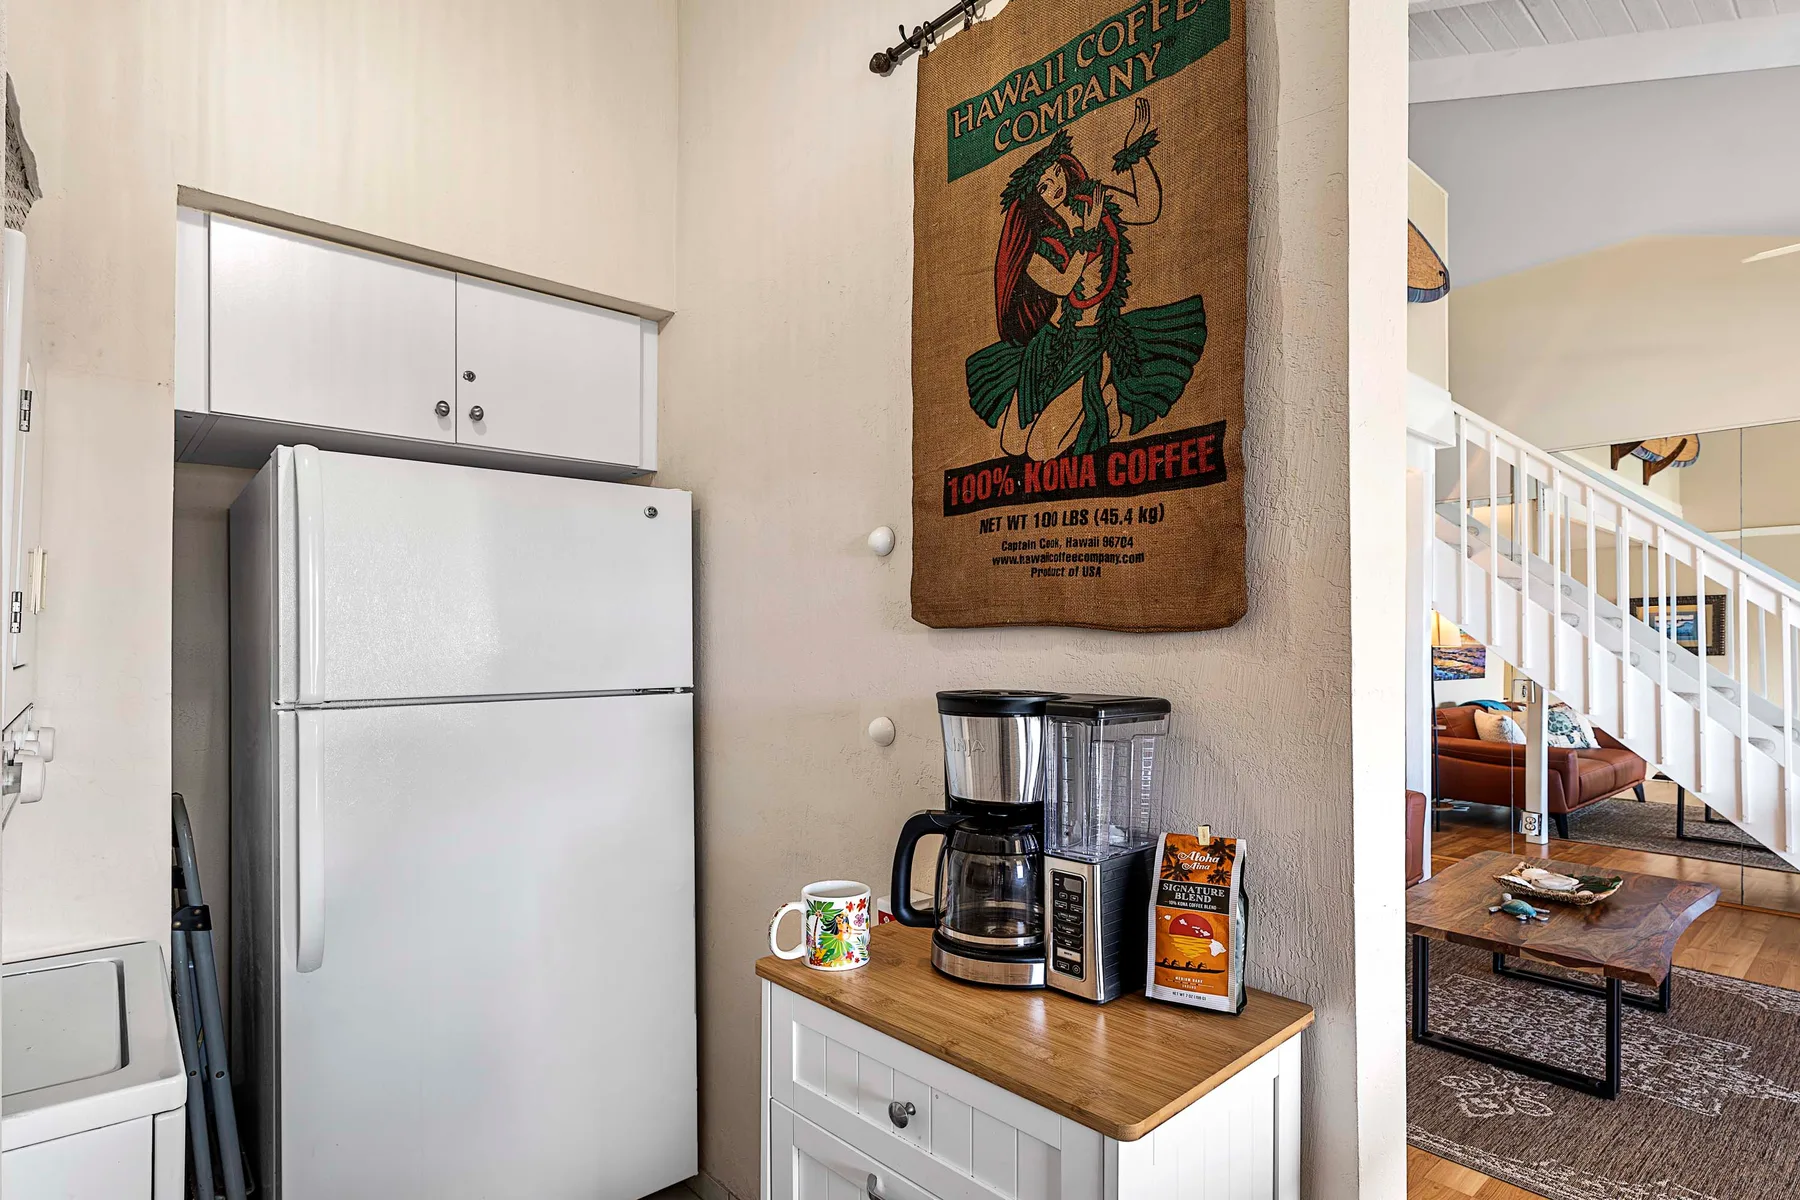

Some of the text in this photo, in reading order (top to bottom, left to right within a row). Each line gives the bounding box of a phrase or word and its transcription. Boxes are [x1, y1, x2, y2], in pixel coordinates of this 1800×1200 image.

[952, 0, 1206, 138] HAWAII COFFE
[993, 42, 1162, 152] COMPANY
[948, 434, 1215, 506] 100% KONA COFFEE
[979, 503, 1165, 534] NET WT 100 LBS (45.4 kg)
[1001, 536, 1134, 552] Captain Cook, Hawaii 96704
[992, 552, 1145, 566] www.hawaiicoffeecompany.com
[1031, 566, 1102, 578] Product of USA
[1178, 851, 1220, 863] Aloha
[1163, 883, 1225, 898] SIGNATURE
[1174, 892, 1212, 903] BLEND
